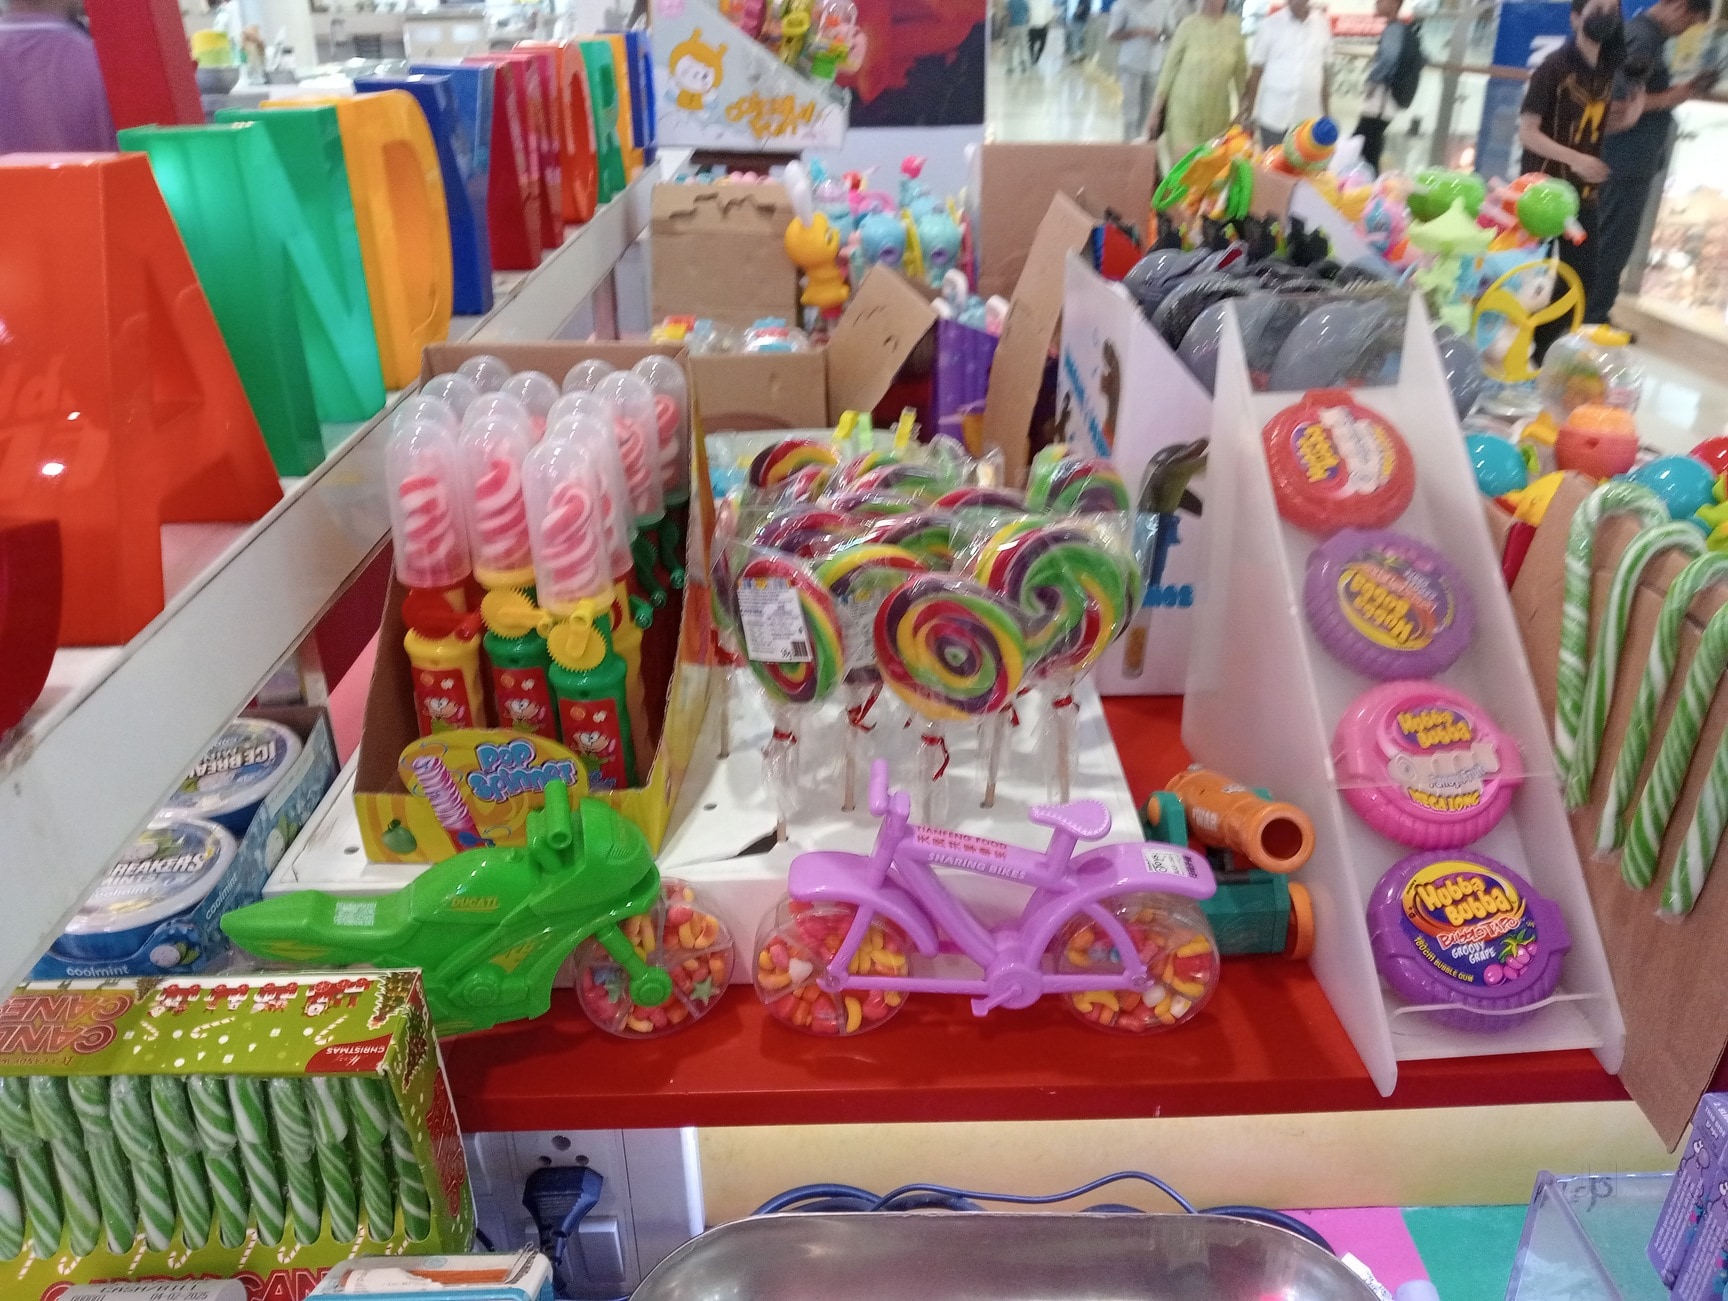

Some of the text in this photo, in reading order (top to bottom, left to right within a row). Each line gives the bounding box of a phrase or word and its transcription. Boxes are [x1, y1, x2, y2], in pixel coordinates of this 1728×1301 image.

[1397, 709, 1454, 735] Hubba
[1417, 721, 1471, 749] Bubba
[244, 740, 277, 766] ICE
[917, 825, 1008, 850] TIANFENG FOOD
[928, 852, 1027, 880] SHARING BIKES
[205, 871, 239, 921] coolmint
[452, 896, 499, 909] DUCATI
[1415, 875, 1486, 912] Hubba
[1444, 886, 1515, 927] Bubba
[1451, 940, 1486, 959] GROOVY
[1468, 946, 1498, 965] GRAPE
[66, 963, 130, 979] coolmint
[1433, 958, 1459, 978] BUBBLE
[1457, 970, 1475, 984] GUM
[0, 994, 133, 1022] CANE
[325, 1044, 386, 1056] CHRISTMAS
